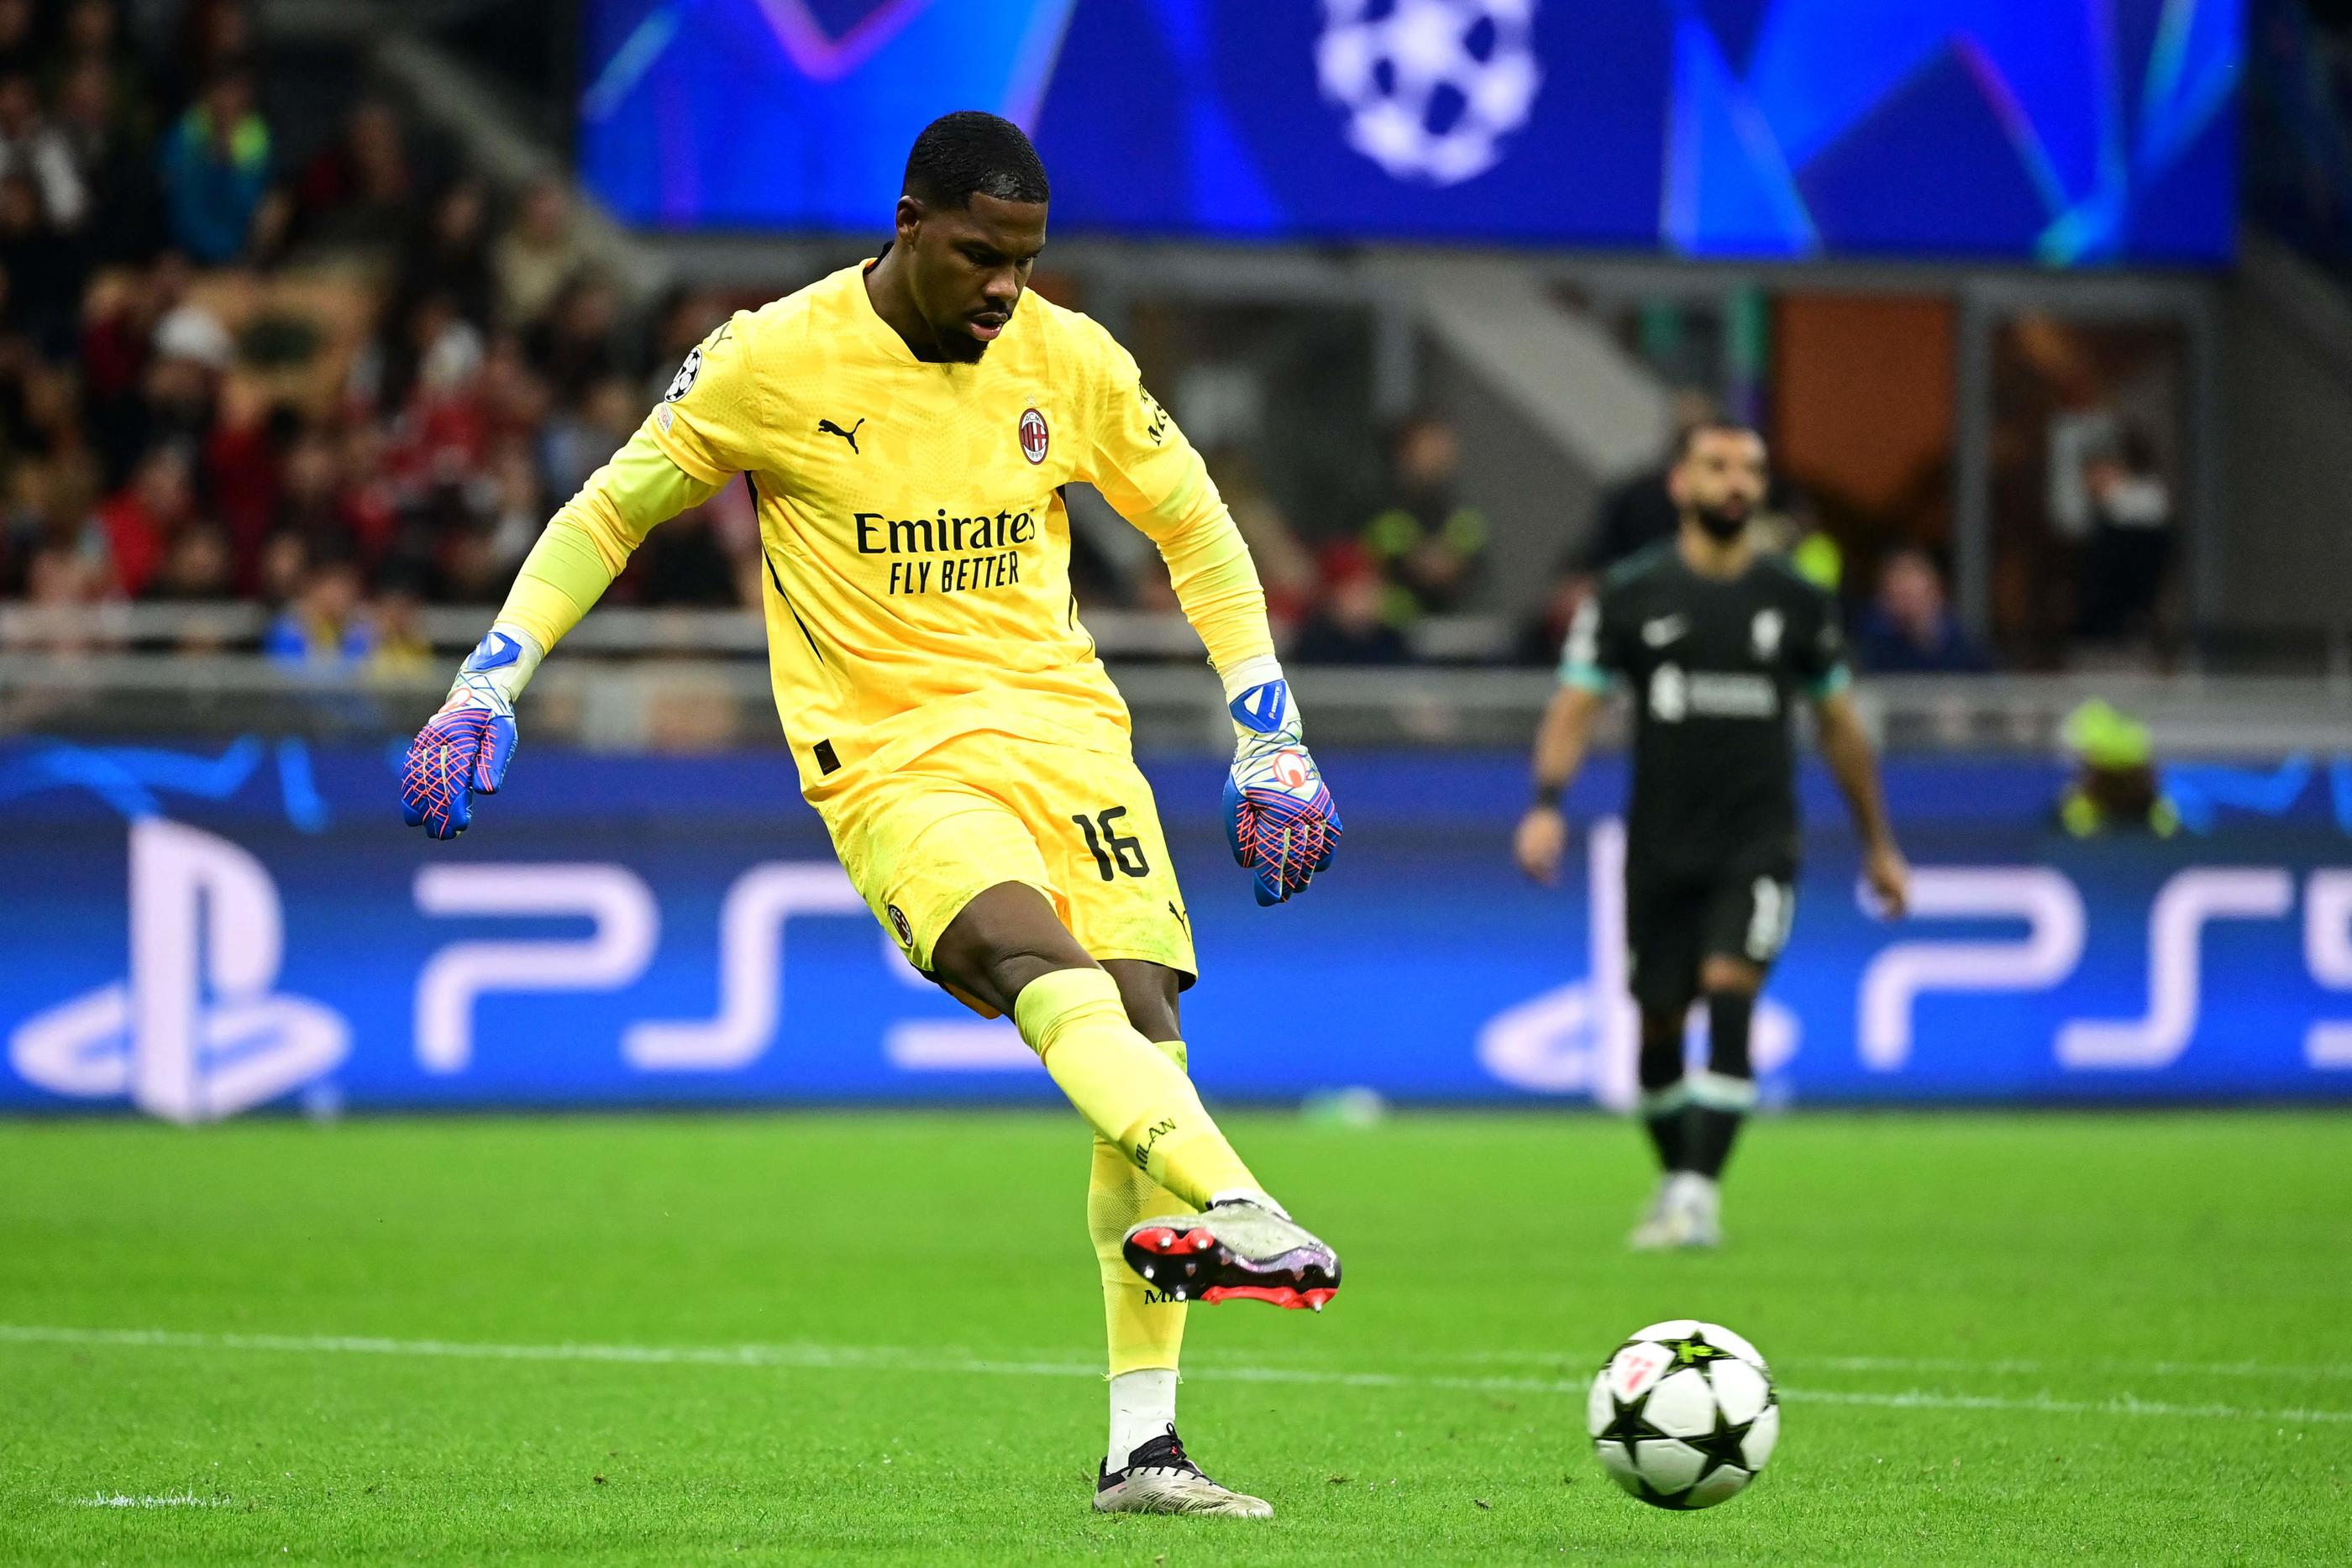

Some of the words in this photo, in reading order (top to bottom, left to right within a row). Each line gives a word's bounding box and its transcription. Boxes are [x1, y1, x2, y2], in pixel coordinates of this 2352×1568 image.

[853, 508, 1036, 554] Emirates
[889, 561, 932, 595] FLY
[941, 550, 1020, 594] BETTER
[1072, 805, 1151, 882] 16
[1855, 865, 2352, 1071] PS
